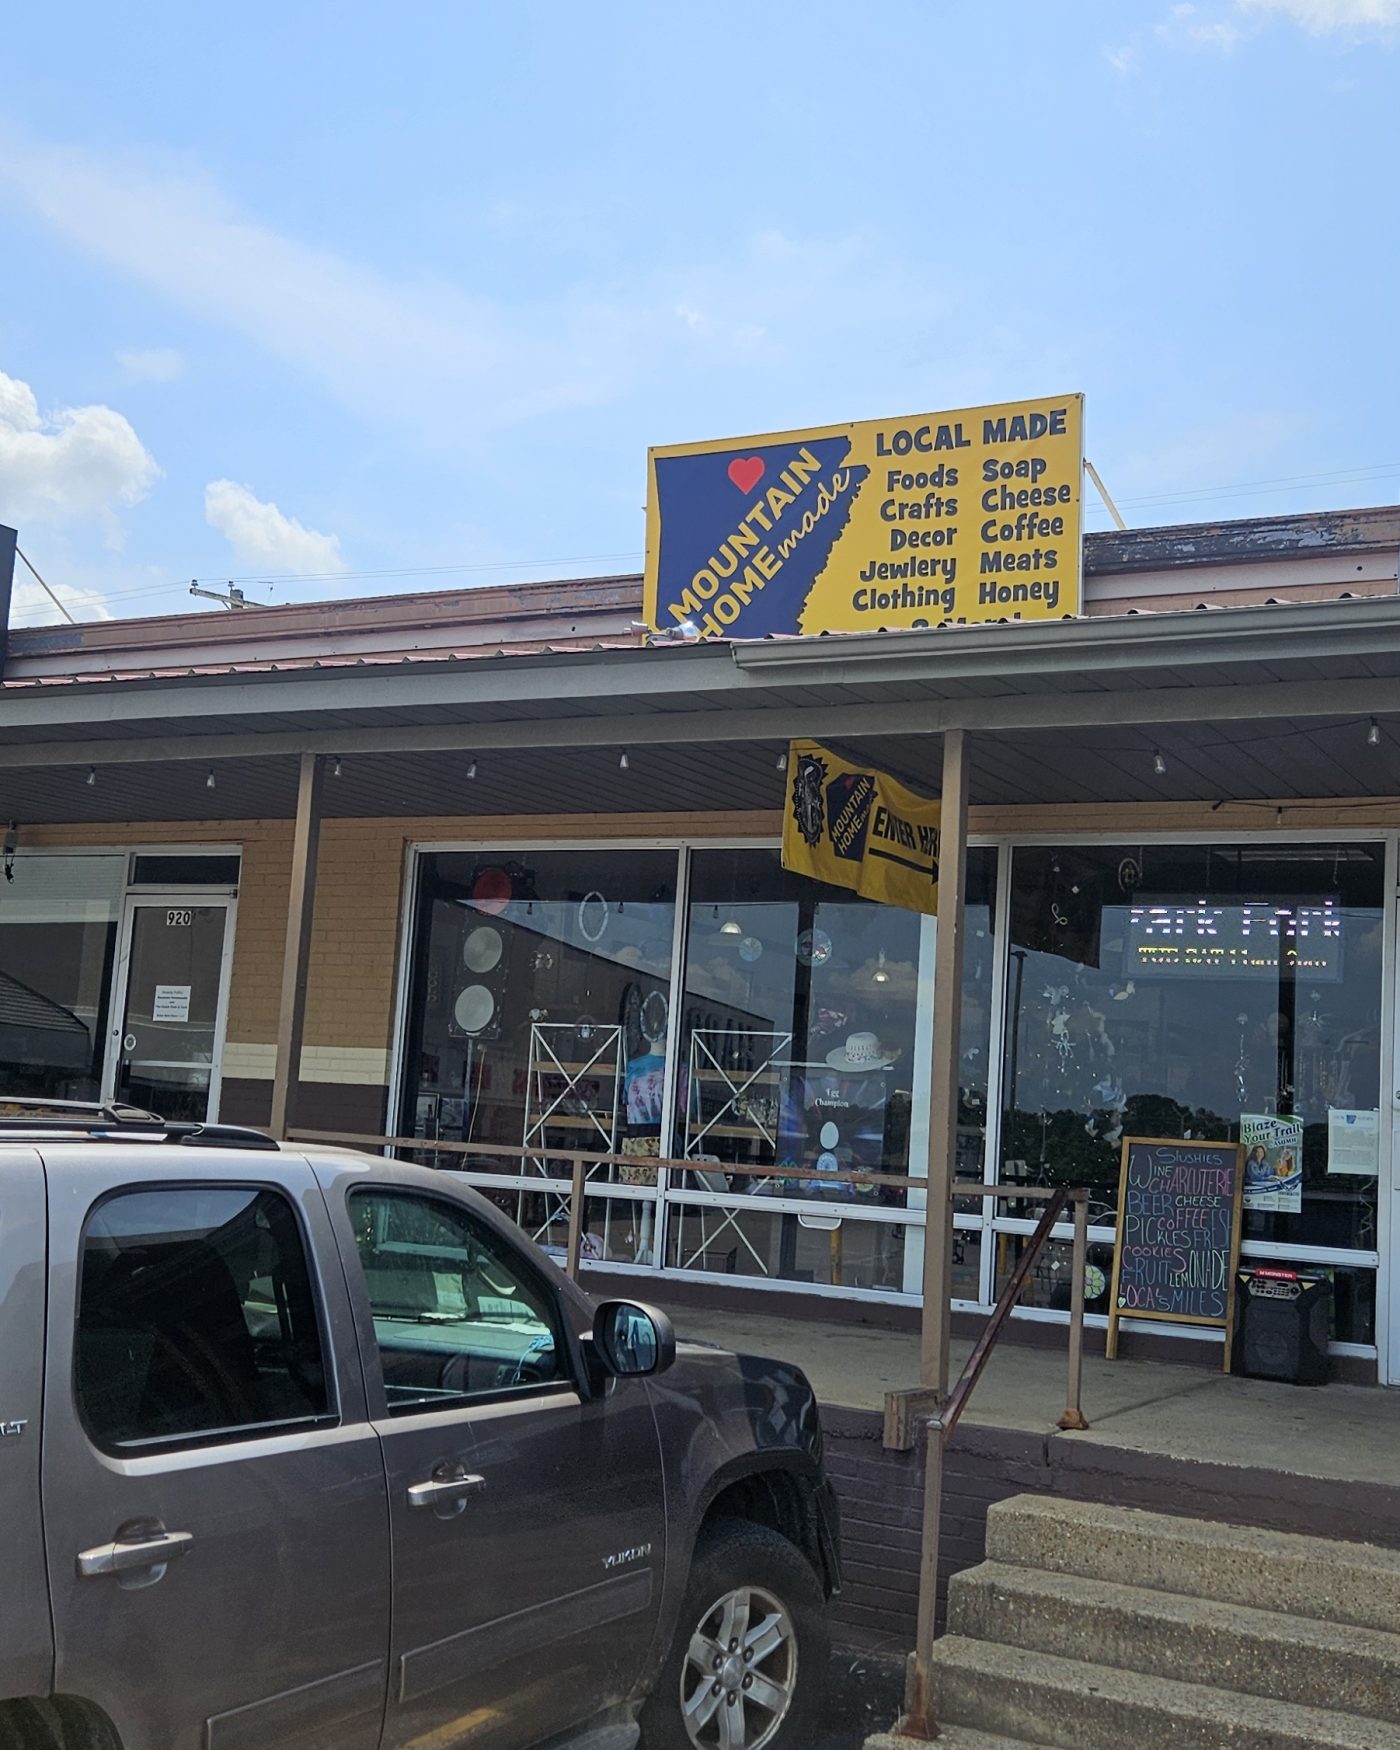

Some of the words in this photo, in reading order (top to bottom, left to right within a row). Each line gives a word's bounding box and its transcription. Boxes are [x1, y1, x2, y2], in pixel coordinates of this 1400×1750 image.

[876, 424, 971, 457] LOCAL
[983, 409, 1067, 445] MADE
[887, 464, 958, 492] Foods
[982, 458, 1047, 483] Soap
[880, 492, 958, 522] Crafts
[981, 485, 1071, 512] Cheese
[668, 448, 822, 624] MOUNTAIN
[891, 527, 958, 552] Decor
[980, 512, 1064, 544] Coffee
[860, 556, 957, 584] Jewlery
[979, 549, 1058, 573] Meats
[852, 583, 955, 613] Clothing
[979, 581, 1060, 609] Honey
[831, 777, 871, 842] MOUNTAIN
[837, 815, 863, 855] HOME
[168, 911, 190, 925] 920
[1243, 1120, 1277, 1134] Blaze
[1243, 1132, 1271, 1144] Your
[1274, 1123, 1300, 1138] Trail
[1127, 1190, 1175, 1217] BEER
[1175, 1195, 1222, 1208] CHEESE
[1126, 1215, 1192, 1249] PICKLES
[1121, 1257, 1172, 1286] FRUIT
[1122, 1246, 1187, 1273] COOKIES
[1169, 1250, 1230, 1291] LEMONADE
[1120, 1284, 1163, 1309] LOCAL
[1157, 1290, 1224, 1317] SMILES
[601, 1543, 652, 1569] YUKON
